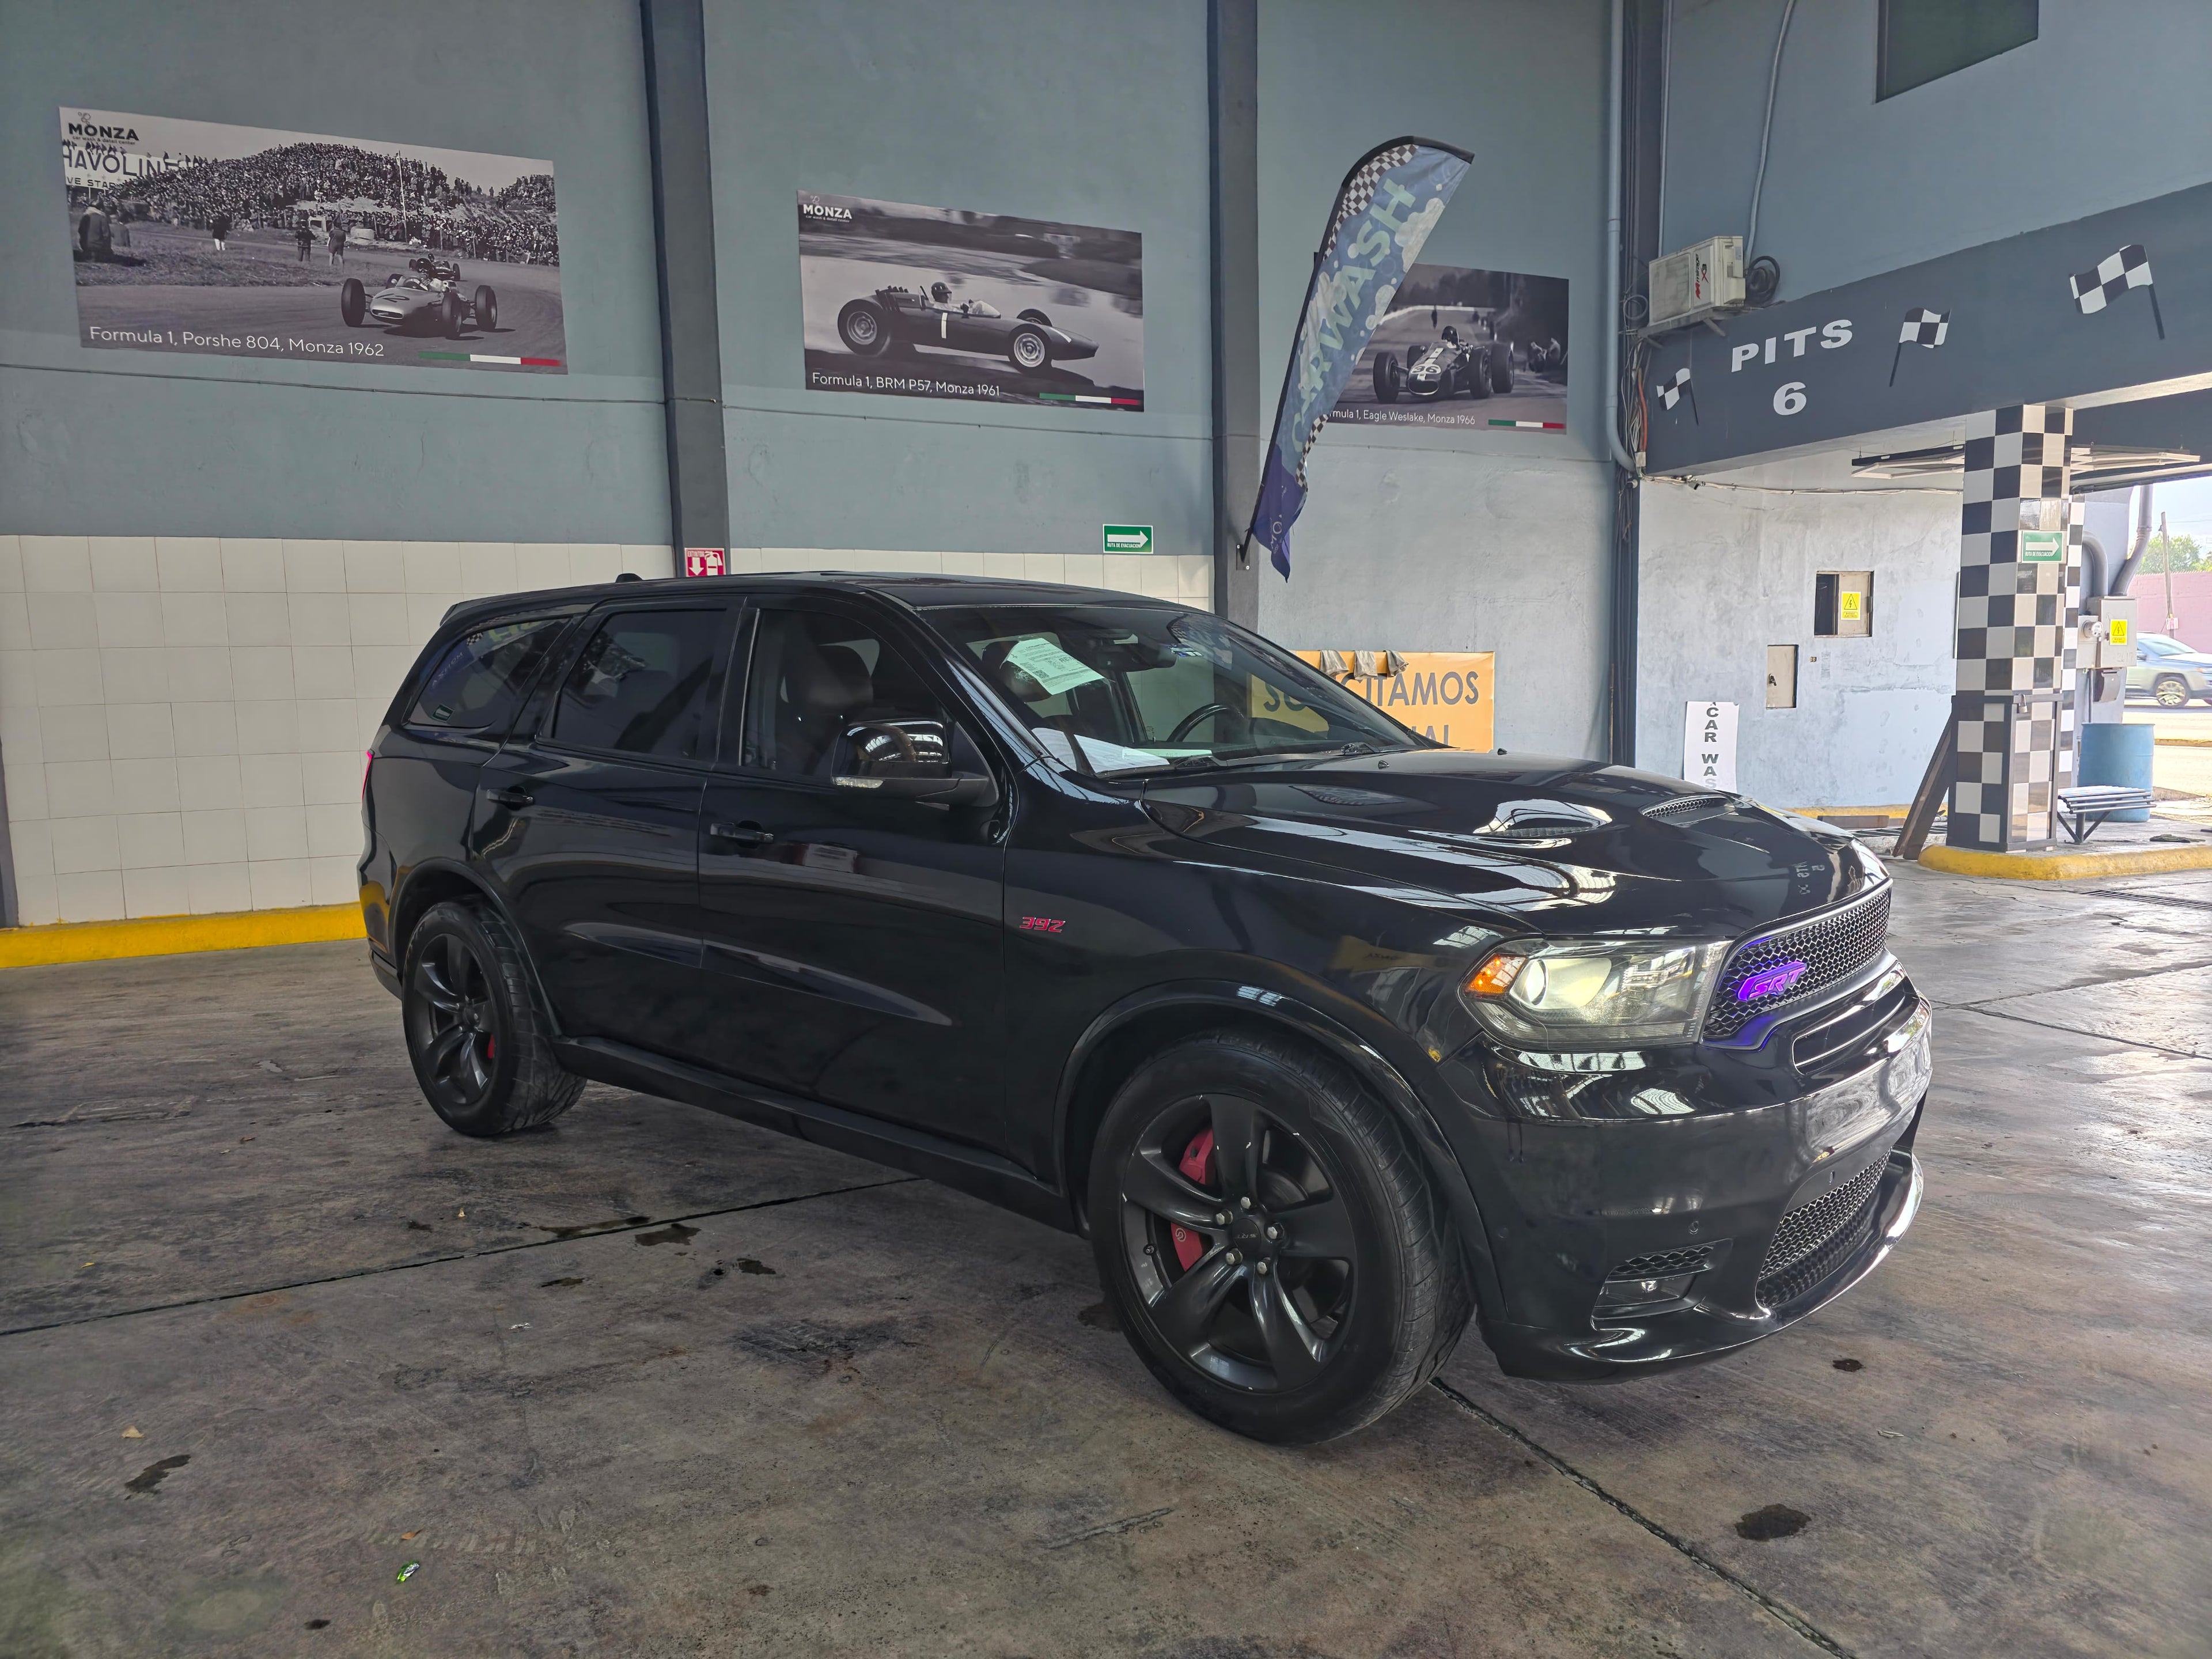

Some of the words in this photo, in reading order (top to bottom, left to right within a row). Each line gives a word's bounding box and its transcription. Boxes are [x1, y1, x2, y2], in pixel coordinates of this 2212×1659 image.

[68, 122, 139, 141] MONZA
[803, 204, 853, 219] MONZA
[1319, 178, 1416, 350] WASH
[89, 326, 162, 344] Formula
[167, 331, 177, 346] 1,
[183, 331, 242, 349] Porshe
[246, 336, 284, 353] 804,
[290, 338, 344, 354] Monza
[348, 342, 385, 357] 1962
[1732, 319, 1853, 373] PITS
[812, 372, 862, 387] Formula
[866, 376, 873, 389] 1,
[876, 377, 905, 390] BRM
[909, 379, 933, 393] P57,
[935, 381, 974, 395] Monza
[977, 384, 1000, 396] 1961
[1412, 365, 1438, 373] 36
[1773, 381, 1807, 416] 6
[1330, 409, 1354, 418] mula
[1357, 410, 1361, 420] 1,
[1363, 410, 1387, 422] Eagle
[1389, 411, 1426, 424] Weslake,
[1427, 413, 1455, 424] Monza
[1457, 414, 1476, 425] 1966
[1704, 707, 1719, 743] CAR
[1701, 753, 1719, 789] WAS
[1019, 916, 1066, 933] 392
[1749, 967, 1806, 998] SRT
